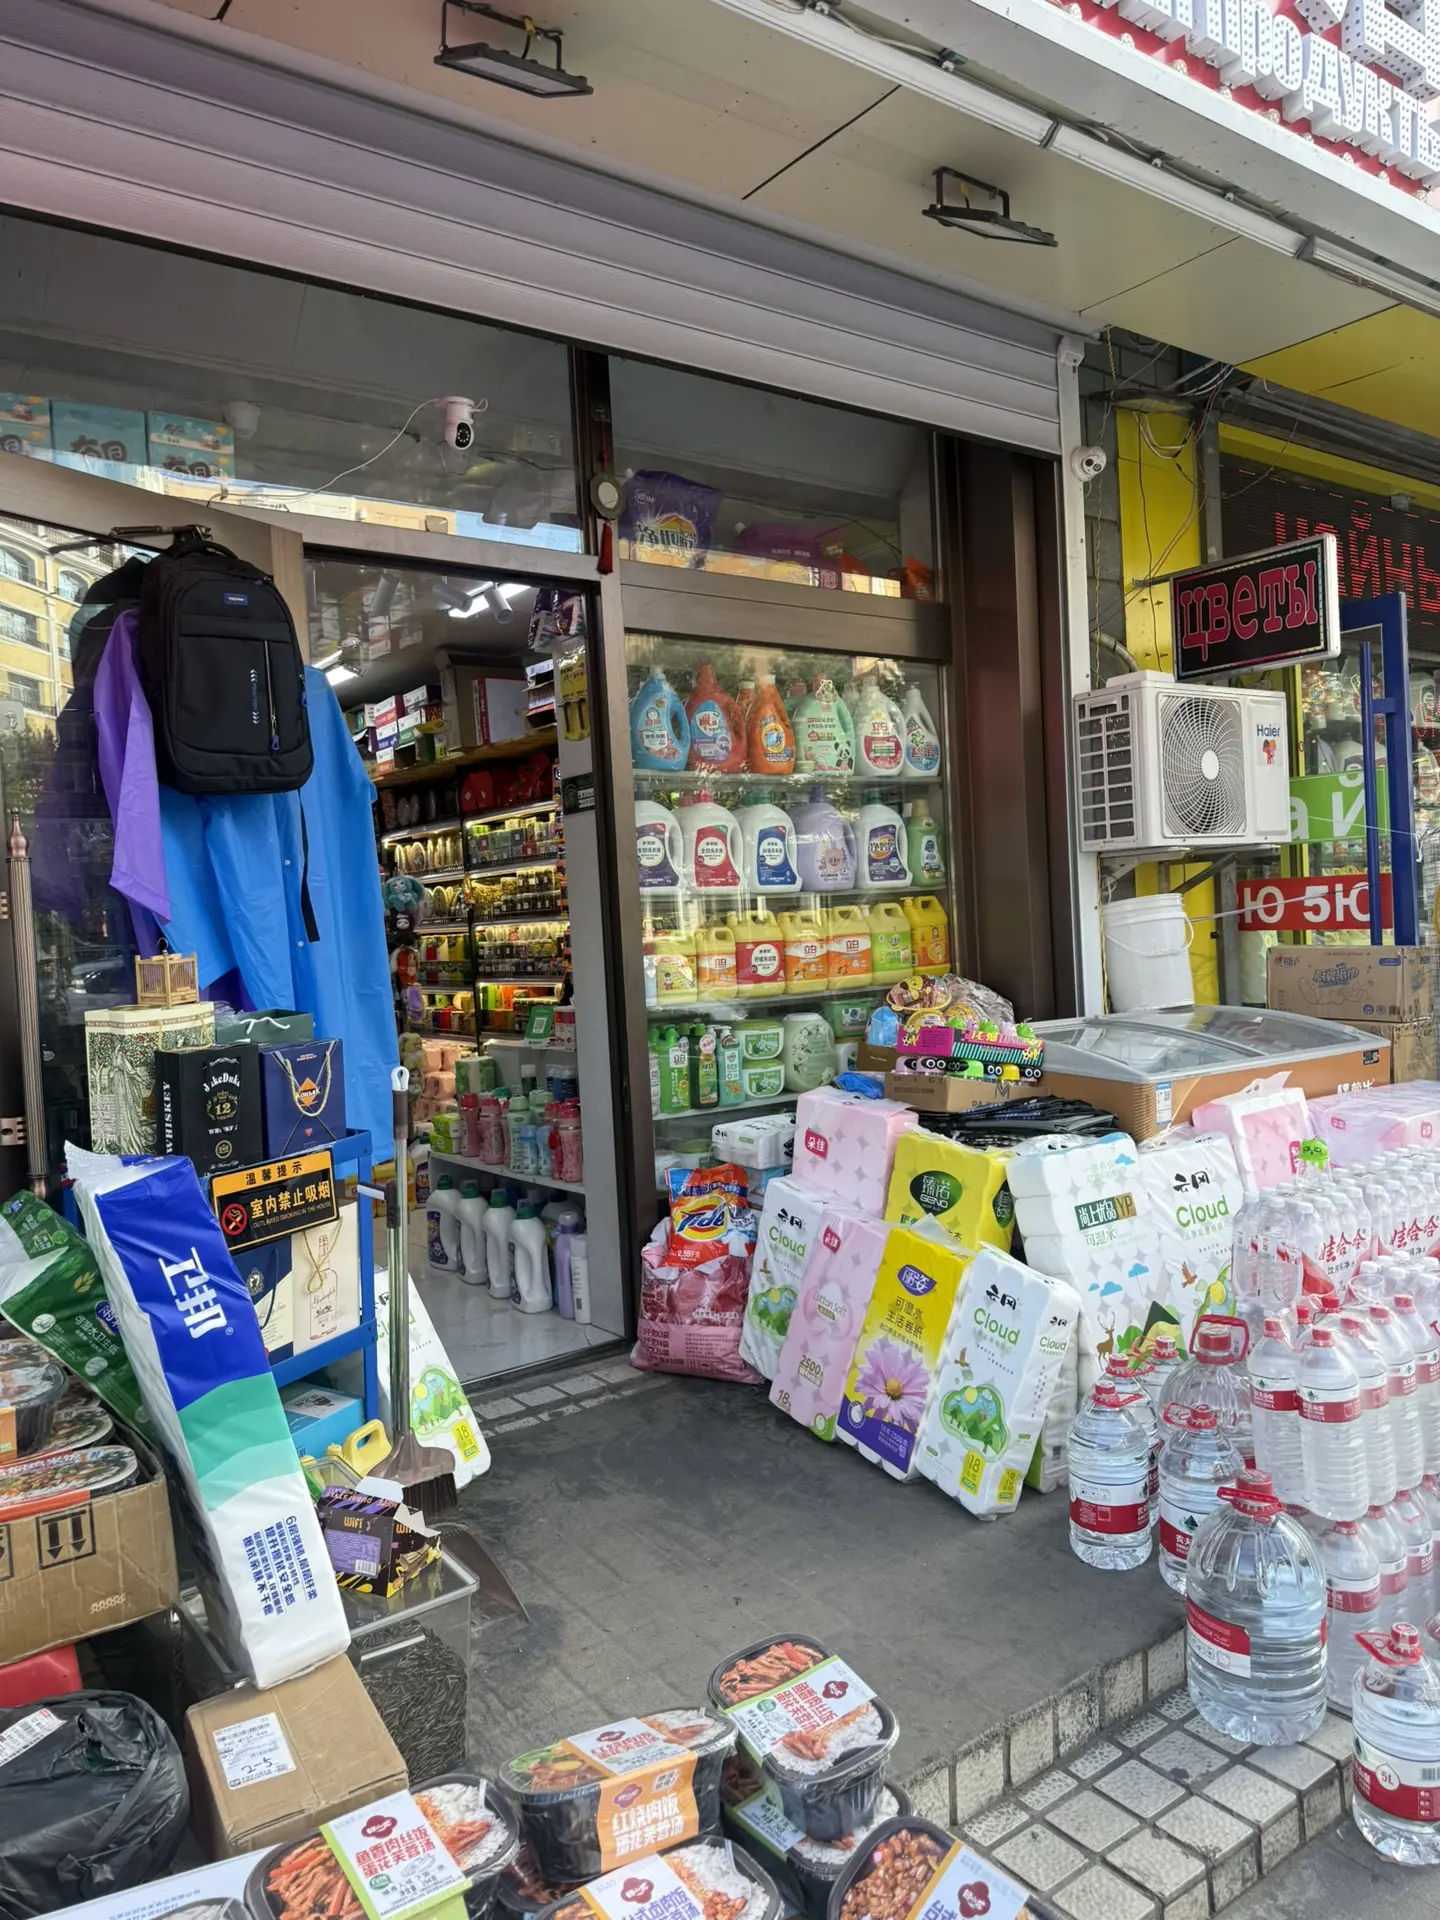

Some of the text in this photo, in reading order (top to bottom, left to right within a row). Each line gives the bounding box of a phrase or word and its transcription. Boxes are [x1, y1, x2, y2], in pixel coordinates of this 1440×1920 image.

[1257, 723, 1281, 737] Haier
[162, 1081, 174, 1154] WHISKEY
[215, 1102, 232, 1116] 12
[806, 1136, 826, 1153] 朵佳
[246, 1160, 304, 1186] 温馨提示
[250, 1180, 331, 1219] 室内禁止吸烟
[280, 1210, 302, 1222] SMOKING
[316, 1201, 332, 1211] HOUSE
[1116, 1194, 1134, 1217] YP
[1176, 1194, 1230, 1228] Cloud
[676, 1203, 725, 1233] Tide
[1389, 1214, 1439, 1248] 娃哈哈
[769, 1225, 806, 1259] Cloud
[823, 1233, 841, 1249] 朵佳
[1319, 1228, 1366, 1263] 娃哈哈
[158, 1246, 228, 1339] 卫邦
[813, 1290, 847, 1318] Cotton Soft
[895, 1296, 924, 1319] 可湿水
[377, 1310, 416, 1339] Cld
[973, 1307, 1021, 1346] Cloud
[1039, 1336, 1068, 1351] Cloud
[969, 1454, 981, 1473] 18
[1381, 1771, 1395, 1786] 5L
[612, 1792, 680, 1835] 红烧肉饭
[356, 1825, 430, 1866] 鱼香肉丝饭
[361, 1840, 436, 1879] 蛋花芙蓉汤
